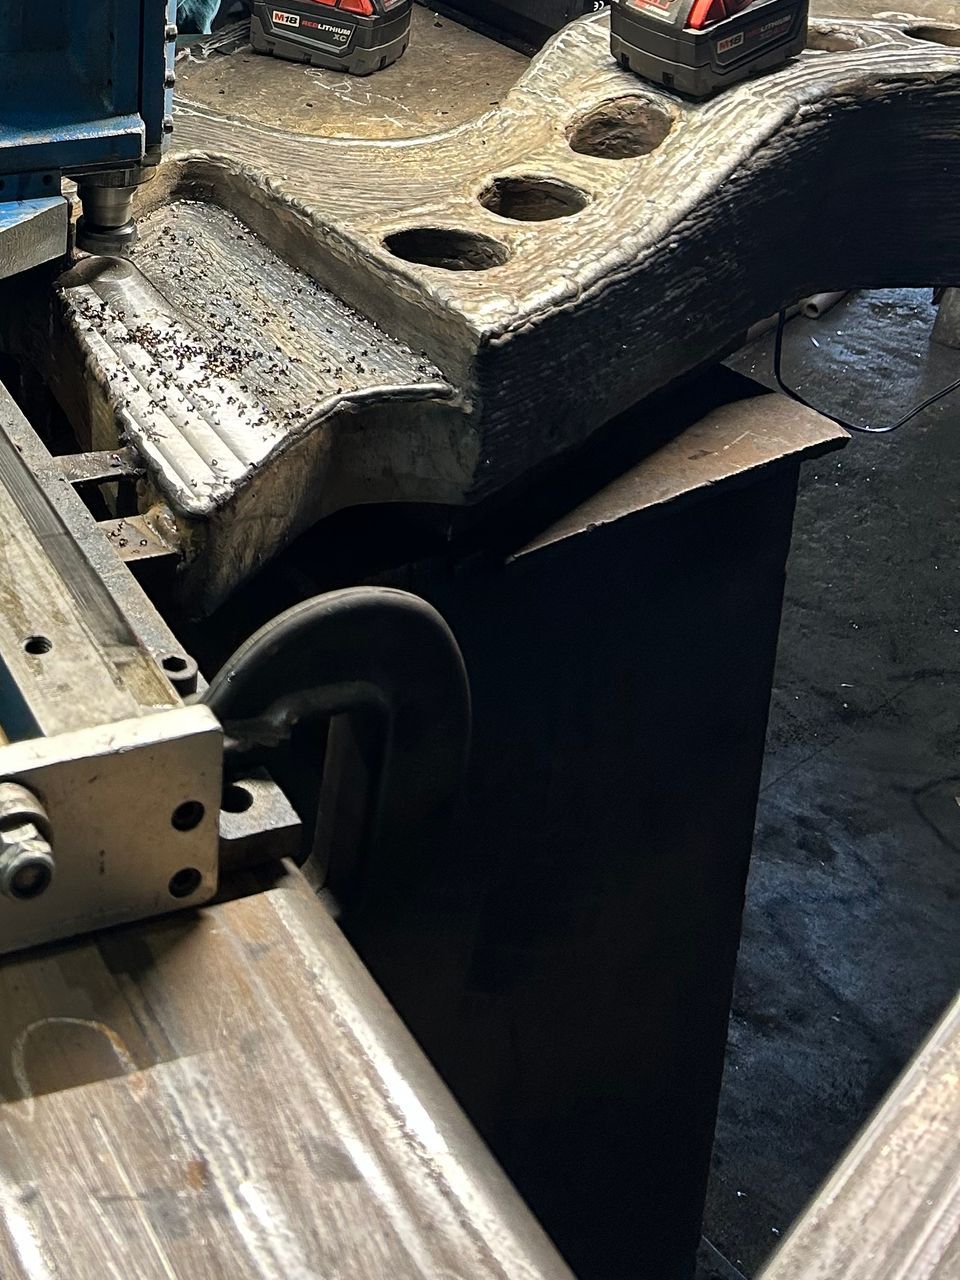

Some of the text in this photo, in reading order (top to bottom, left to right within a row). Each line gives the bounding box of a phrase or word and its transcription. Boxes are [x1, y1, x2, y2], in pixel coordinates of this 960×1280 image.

[274, 12, 351, 36] M18 REDLITHIUM
[332, 33, 347, 43] XC
[719, 35, 743, 52] M18
